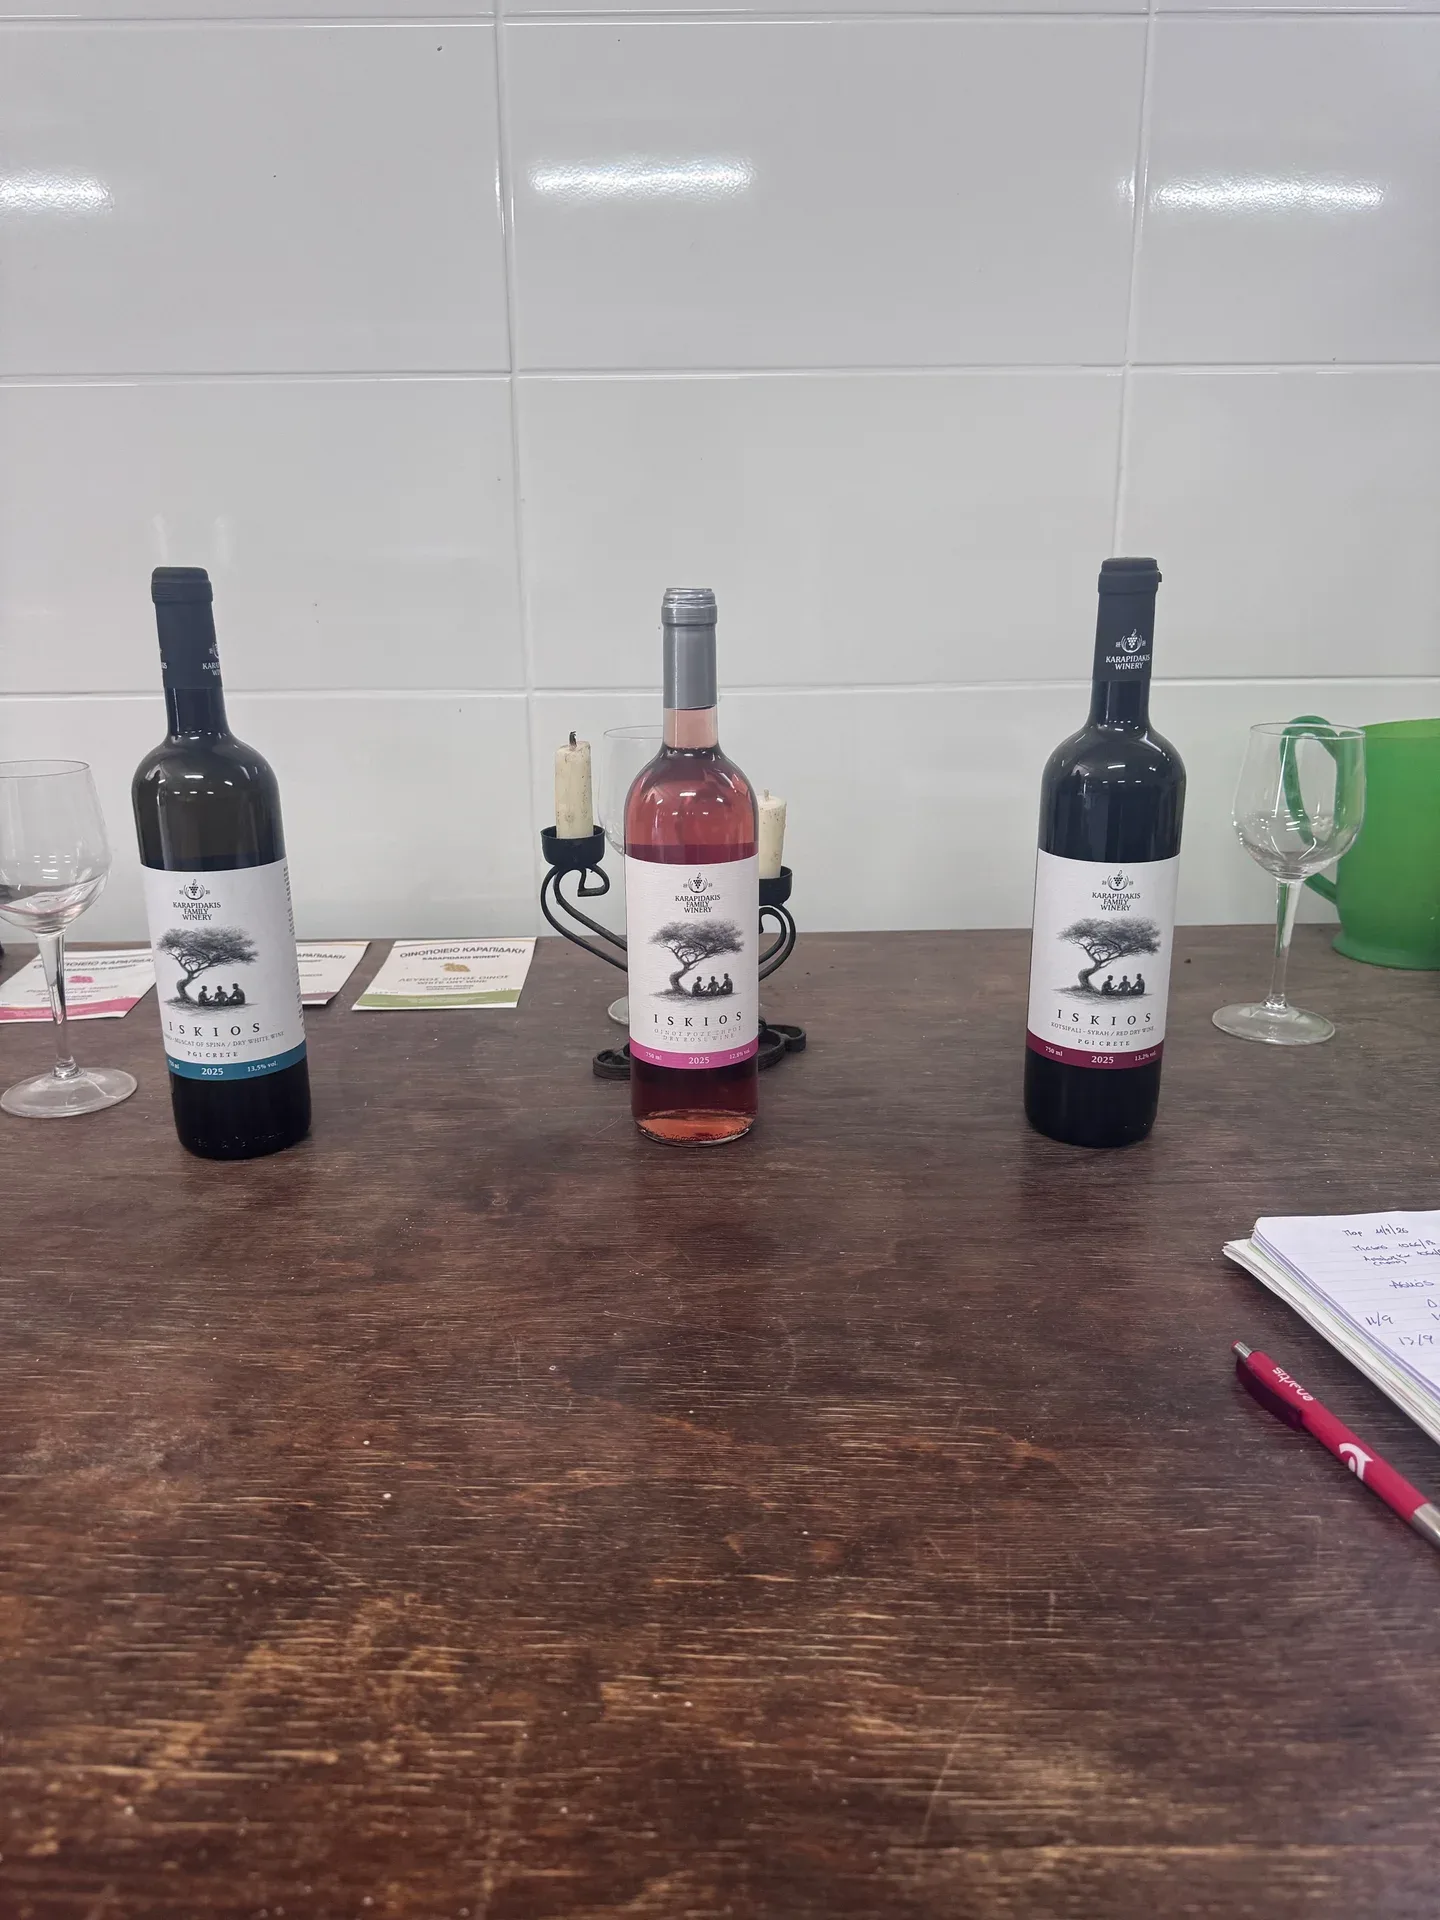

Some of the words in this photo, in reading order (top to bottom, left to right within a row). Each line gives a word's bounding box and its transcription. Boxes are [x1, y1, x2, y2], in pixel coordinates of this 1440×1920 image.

[1105, 654, 1150, 663] KARAPIDAKIS
[1115, 662, 1143, 670] WINERY
[675, 894, 721, 902] KARAPIDAKIS
[400, 947, 460, 959] ΟΙΝΟΠΟΙΕΙΟ
[462, 946, 527, 955] ΚΑΡΑΠΙΔΑΚΗ
[654, 1011, 742, 1027] ISKIOS
[1057, 1009, 1151, 1026] ISKIOS
[168, 1021, 261, 1037] ISKIOS
[1050, 1022, 1082, 1034] KOTSIFALI
[1087, 1029, 1109, 1037] SYRAH
[1115, 1029, 1129, 1037] RED
[1129, 1028, 1141, 1036] DRY
[248, 1036, 270, 1045] WHITE
[270, 1031, 285, 1040] WINE
[663, 1035, 680, 1043] DRY
[712, 1033, 735, 1041] WINE
[1077, 1038, 1095, 1046] PGI
[1045, 1046, 1055, 1054] 750
[645, 1051, 655, 1060] 750
[1091, 1056, 1114, 1064] 2025
[688, 1057, 710, 1065] 2025
[201, 1067, 224, 1076] 2025
[1365, 1311, 1394, 1326] 11/9
[1272, 1366, 1314, 1402] enartis
